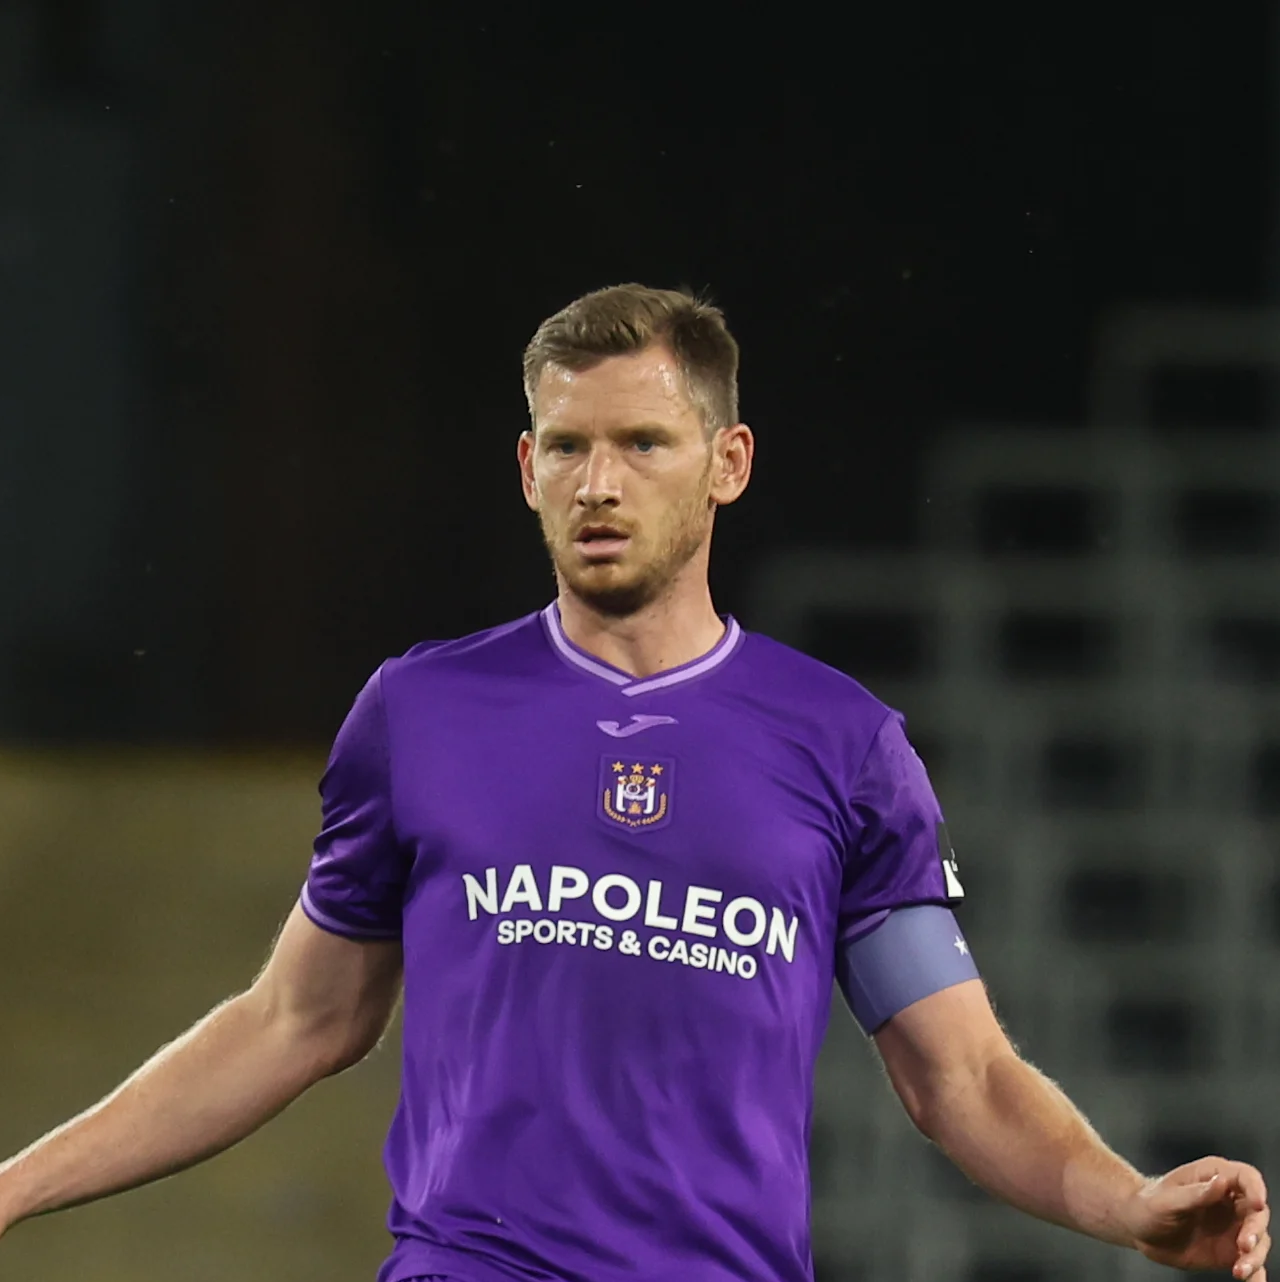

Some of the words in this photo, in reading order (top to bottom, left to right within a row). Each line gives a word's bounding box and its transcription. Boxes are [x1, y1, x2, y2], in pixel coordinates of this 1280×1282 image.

[462, 864, 798, 963] NAPOLEON
[497, 919, 614, 950] SPORTS
[619, 930, 642, 956] &
[648, 935, 757, 980] CASINO
